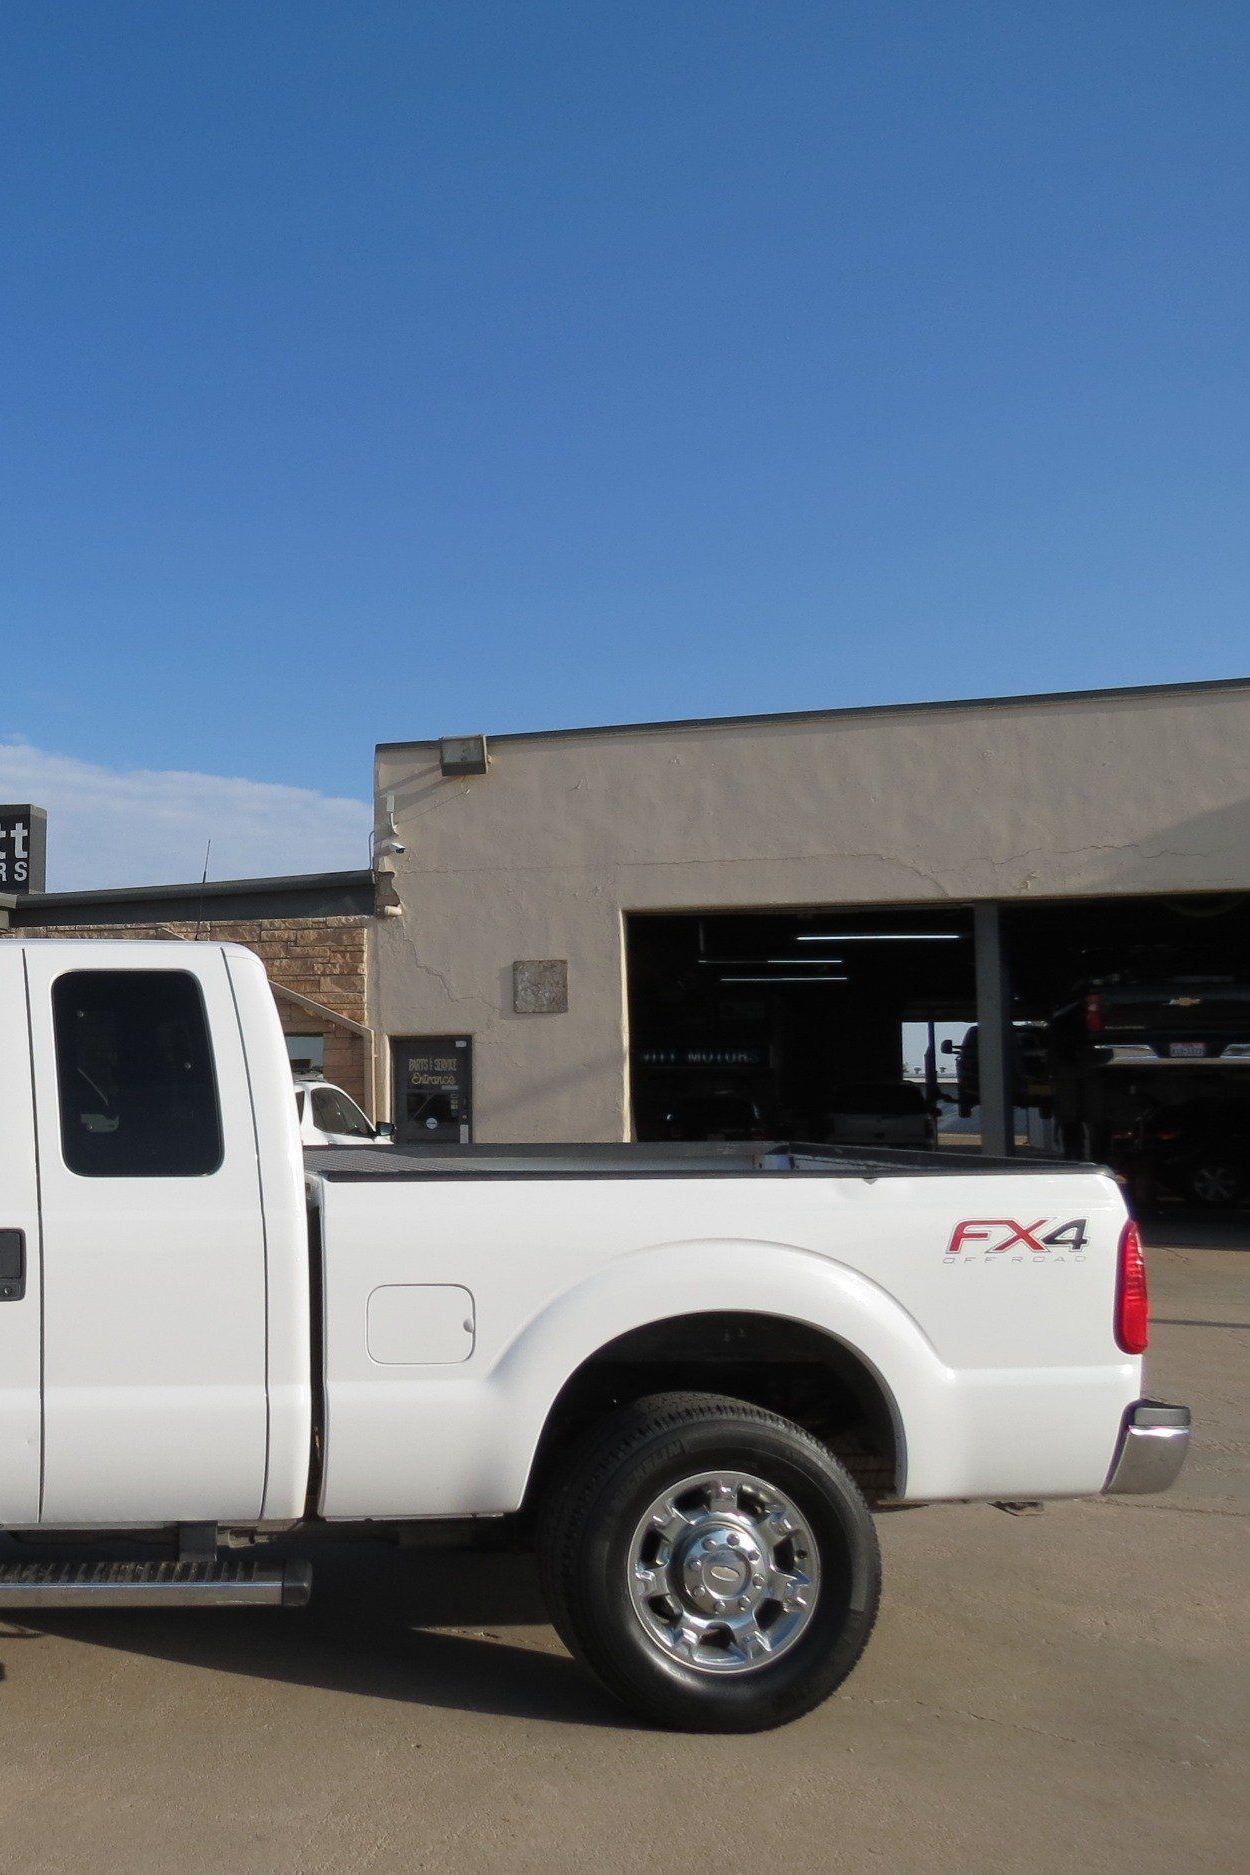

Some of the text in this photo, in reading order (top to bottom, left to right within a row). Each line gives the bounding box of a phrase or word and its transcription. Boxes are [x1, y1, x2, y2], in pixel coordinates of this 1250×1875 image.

[409, 1058, 429, 1071] PARTS
[411, 1072, 456, 1085] Entrance
[945, 1217, 1091, 1254] FX4
[942, 1255, 1088, 1264] OFF ROAD
